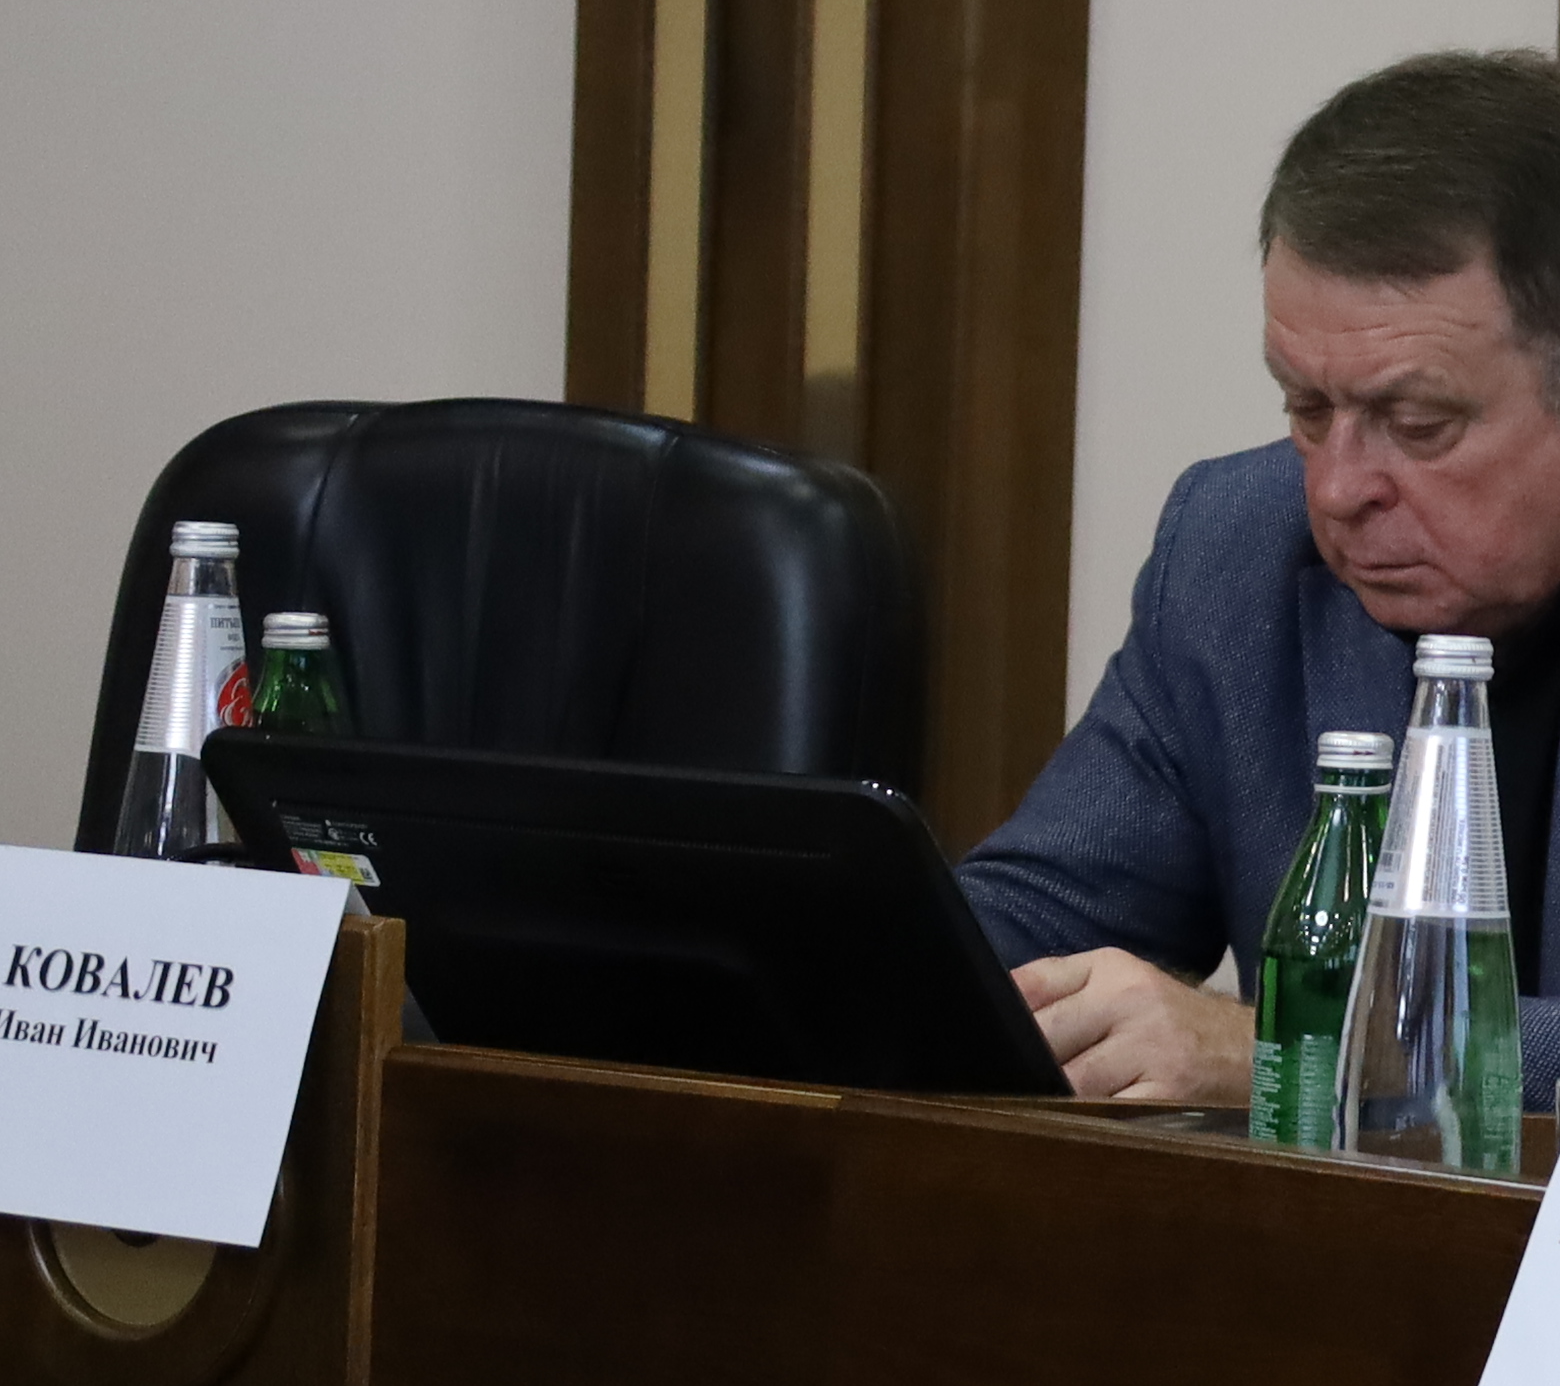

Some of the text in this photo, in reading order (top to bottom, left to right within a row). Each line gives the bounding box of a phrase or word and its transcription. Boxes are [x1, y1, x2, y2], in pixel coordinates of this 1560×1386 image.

[3, 944, 235, 1010] КОВАЛЕВ
[0, 1009, 219, 1065] Иван Иванович
